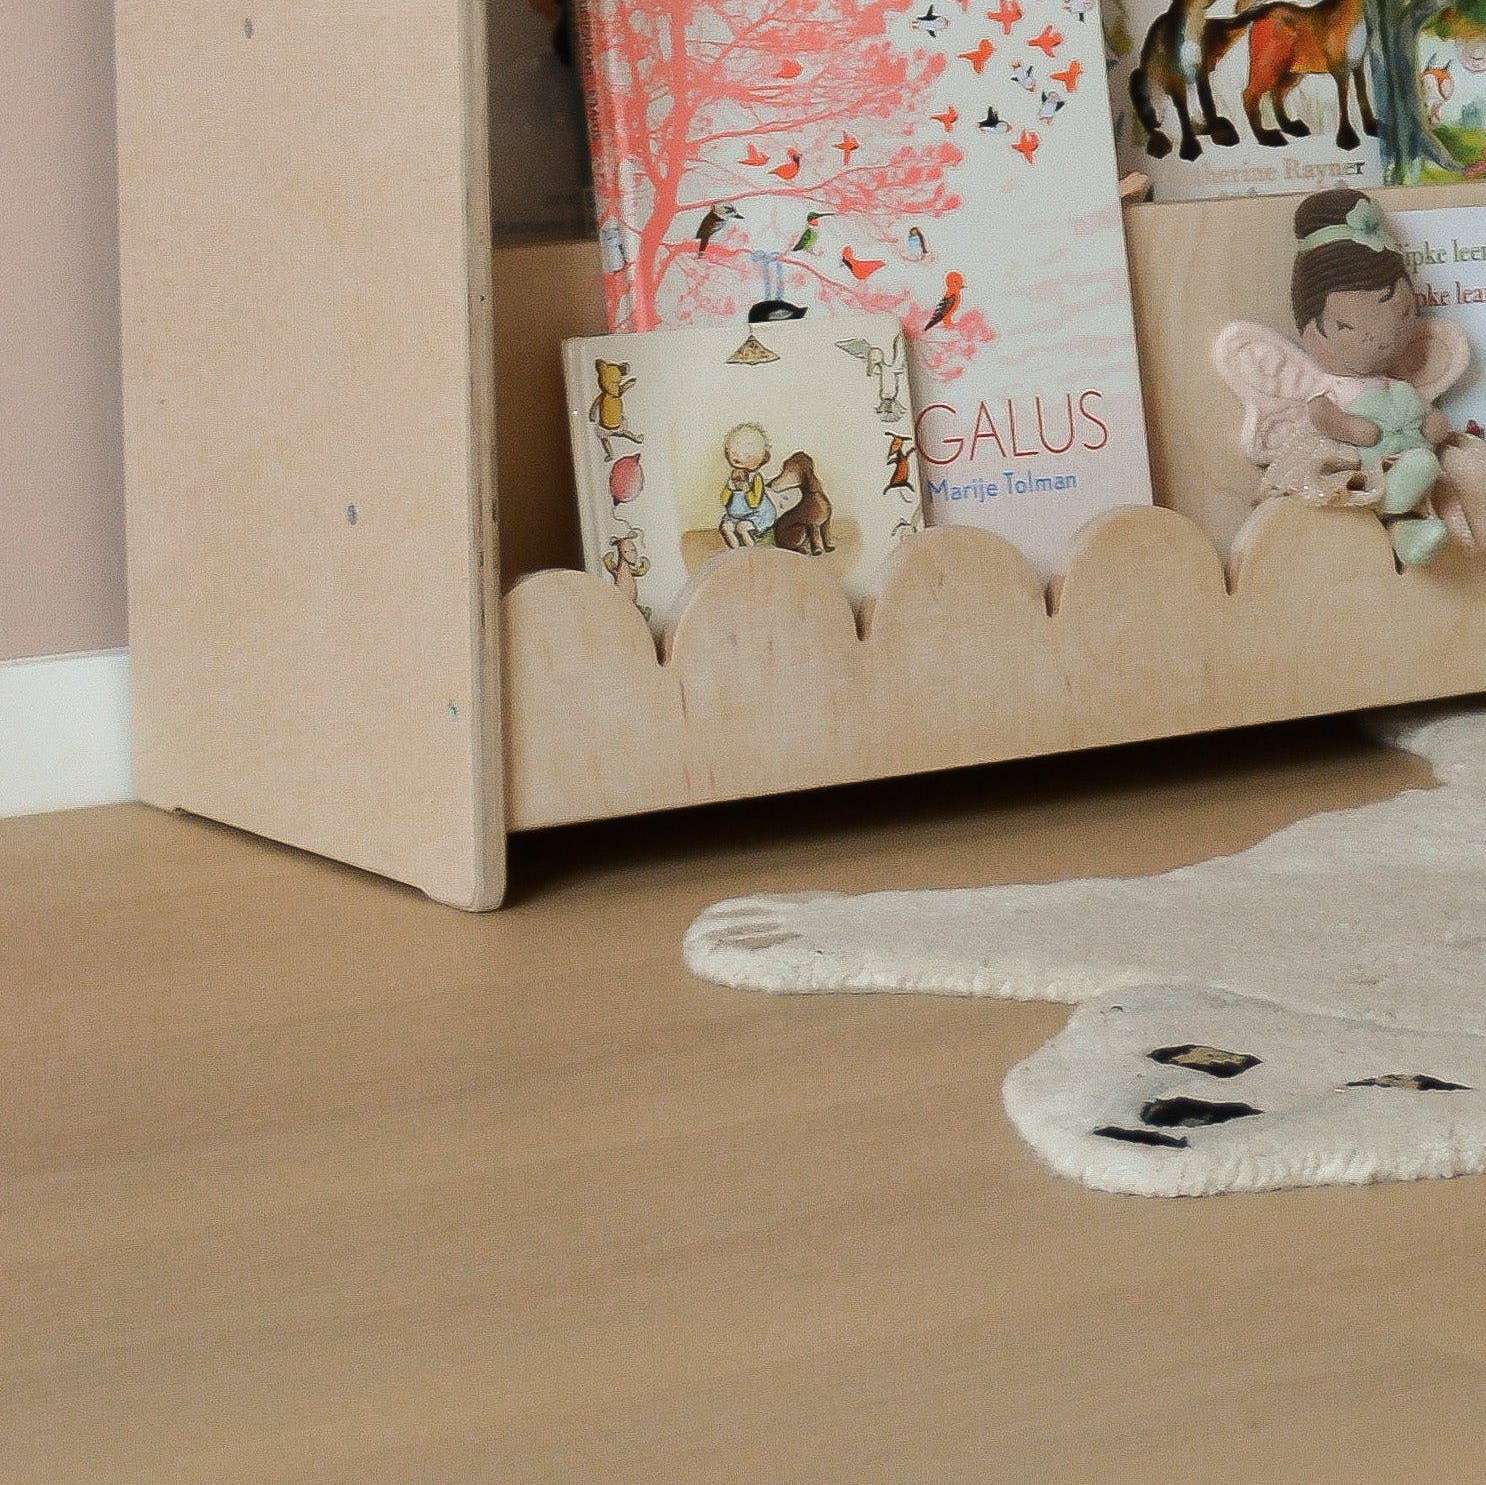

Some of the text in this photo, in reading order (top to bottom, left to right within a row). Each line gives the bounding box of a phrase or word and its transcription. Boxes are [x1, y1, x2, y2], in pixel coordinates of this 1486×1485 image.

[1282, 156, 1366, 185] Rayner
[1397, 241, 1447, 274] ipke
[915, 389, 1109, 465] GALUS
[927, 470, 1078, 504] Marije Tolman
